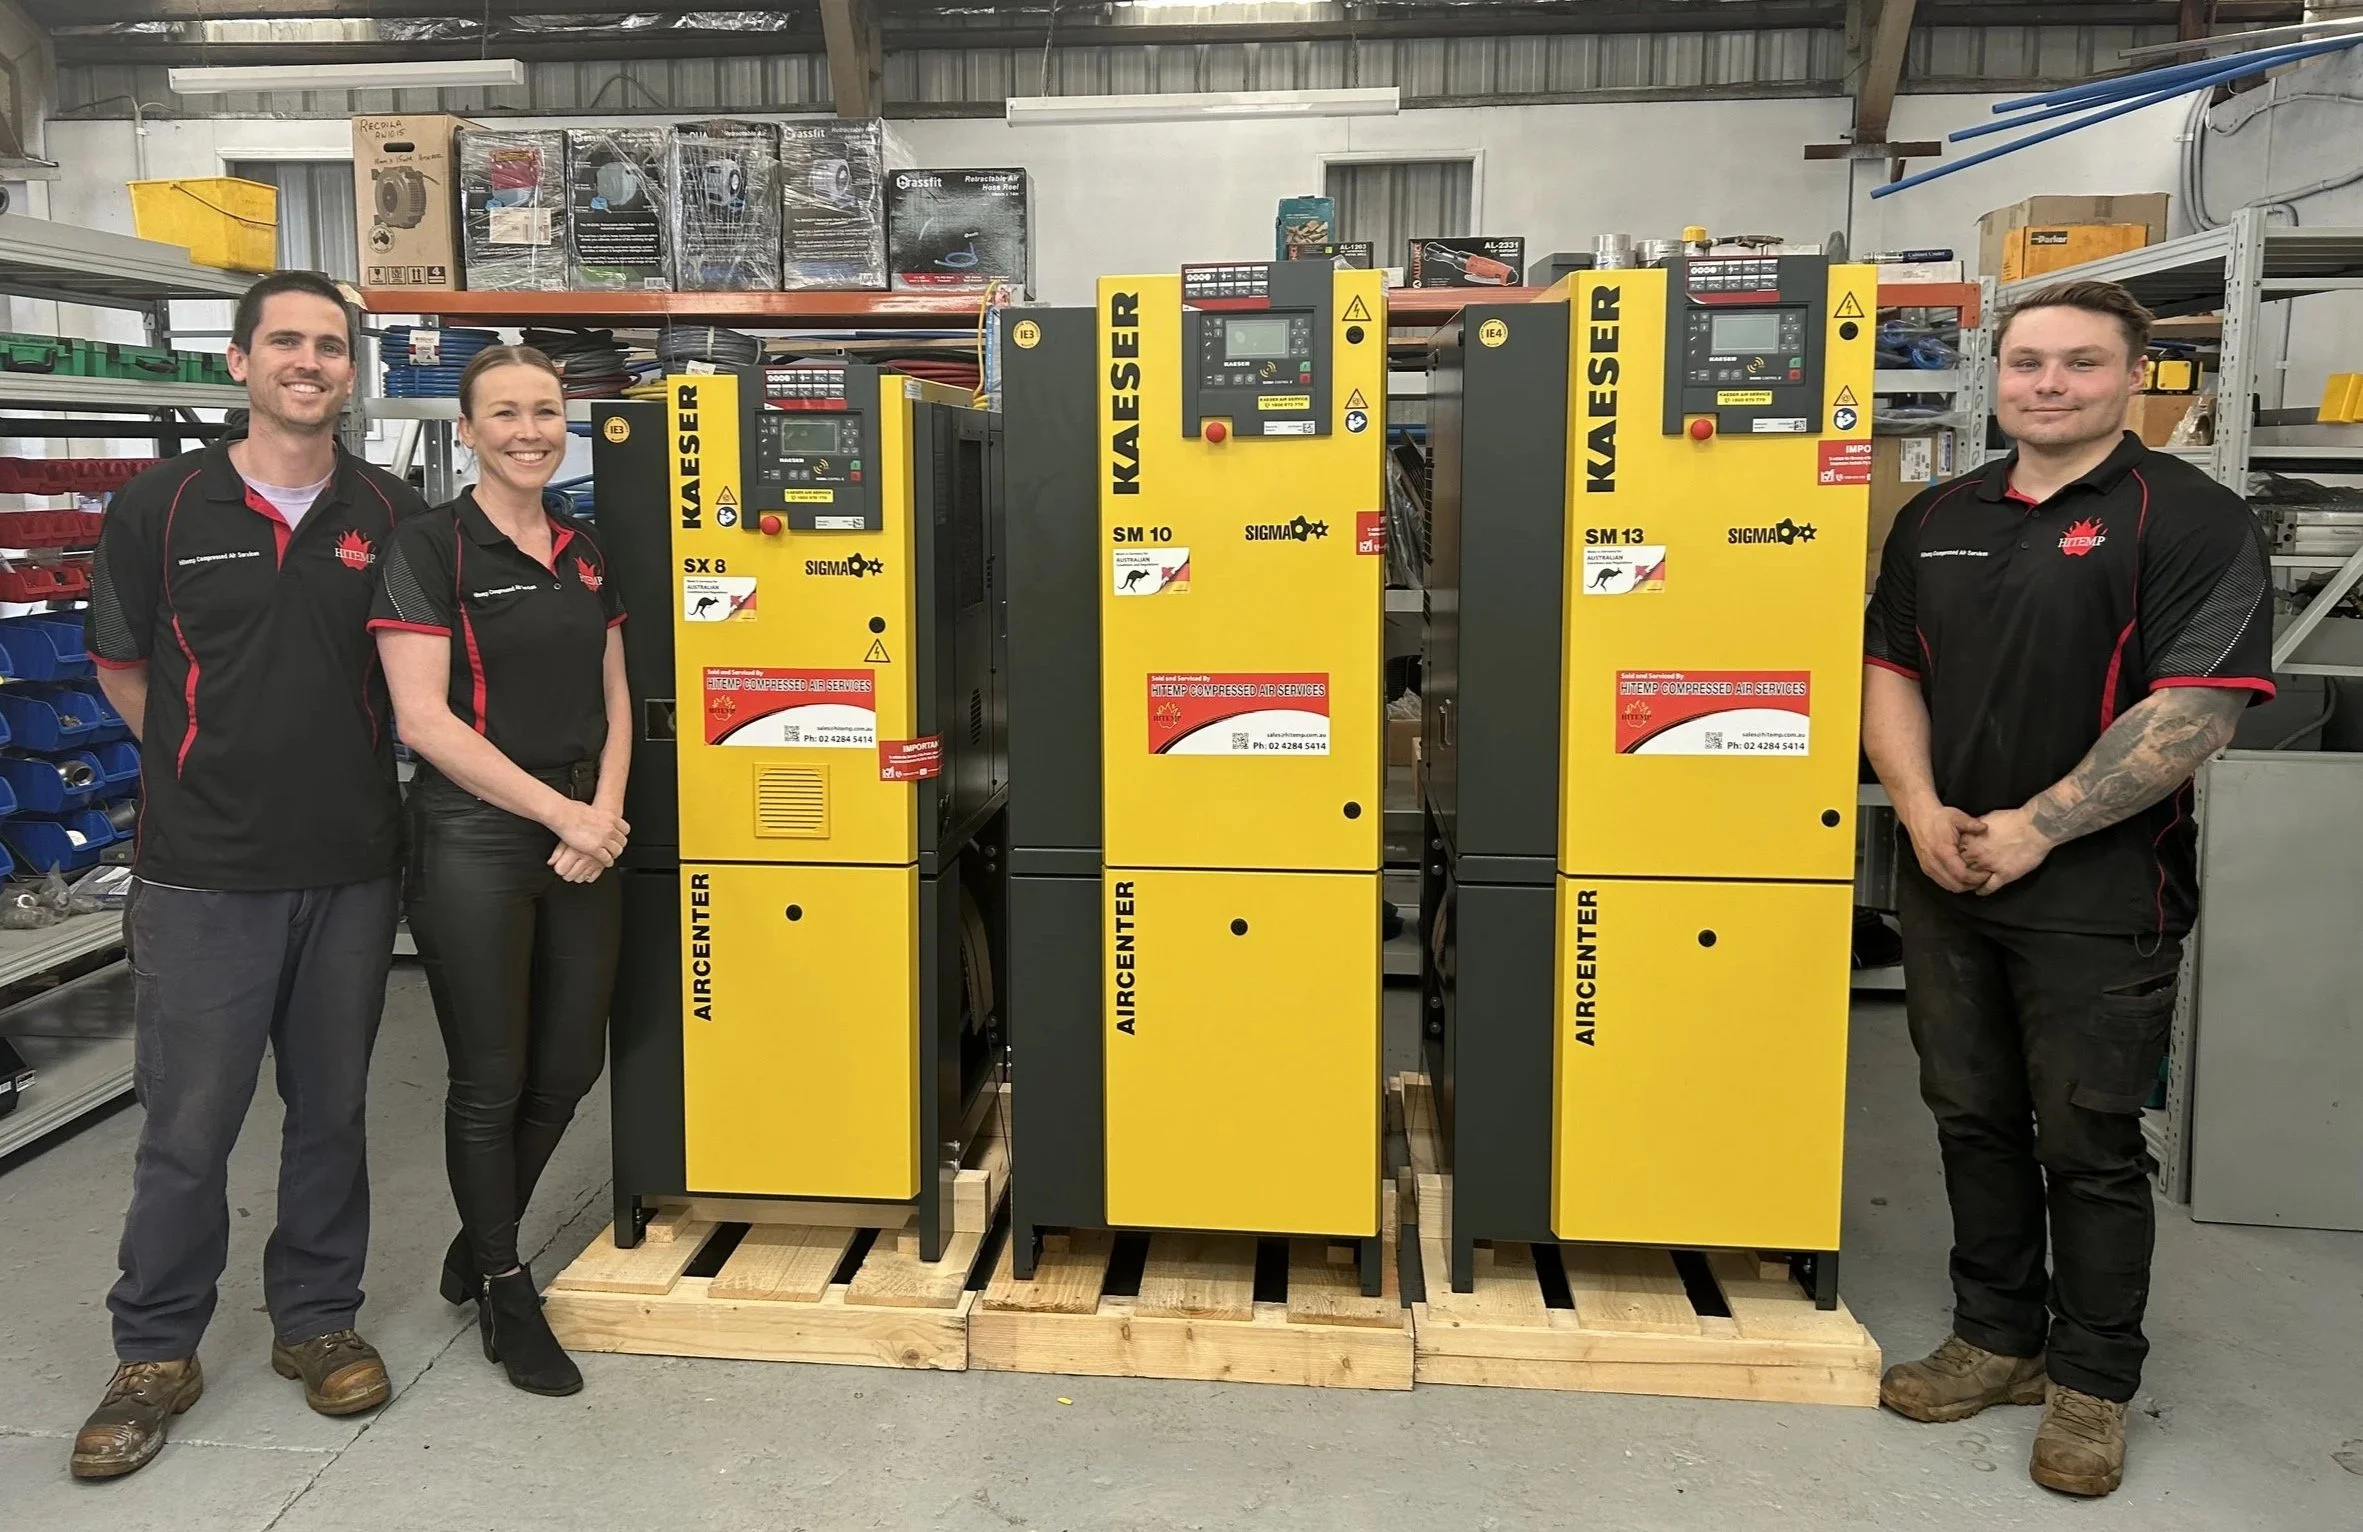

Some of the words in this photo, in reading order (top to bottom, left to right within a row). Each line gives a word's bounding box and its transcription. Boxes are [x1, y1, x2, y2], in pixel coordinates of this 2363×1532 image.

[1009, 174, 1020, 182] Air
[1484, 241, 1519, 249] AL-2331
[2037, 234, 2067, 244] Parker
[1020, 329, 1035, 339] IE3
[1486, 328, 1502, 338] IE4
[1110, 291, 1141, 495] KAESER
[1586, 285, 1620, 493] KAESER
[610, 425, 624, 434] IE3
[679, 385, 702, 529] KAESER
[1113, 527, 1144, 542] SM
[1150, 526, 1172, 542] 10
[1245, 525, 1291, 541] SIGMA
[1585, 528, 1617, 544] SM
[1621, 528, 1644, 544] 13
[1728, 528, 1777, 544] SIGMA
[2057, 535, 2106, 548] HITEMP
[196, 553, 228, 562] Compressed
[334, 547, 376, 564] HITEMP
[684, 558, 710, 574] SX
[715, 559, 726, 574] 8
[806, 560, 849, 576] SIGMA
[756, 670, 764, 678] By
[1202, 675, 1211, 683] By
[1620, 672, 1634, 680] Sold
[1634, 672, 1646, 680] and
[1647, 672, 1674, 680] Serviced
[1675, 673, 1684, 681] By
[708, 677, 741, 691] HITEMP
[743, 678, 807, 692] COMPRESSED
[809, 680, 825, 692] AIR
[826, 680, 872, 692] SERVICES
[1151, 684, 1188, 697] HITEMP
[1189, 684, 1257, 697] COMPRESSED
[1259, 684, 1276, 697] AIR
[1277, 684, 1325, 697] SERVICES
[1620, 682, 1659, 695] HITEMP
[1661, 682, 1733, 695] COMPRESSED
[1735, 682, 1754, 695] AIR
[1755, 682, 1806, 695] SERVICES
[803, 734, 818, 743] Ph:
[818, 735, 830, 743] 02
[831, 735, 851, 743] 4284
[852, 735, 873, 744] 5414
[1253, 741, 1267, 750] Ph:
[1268, 742, 1280, 750] 02
[1281, 742, 1303, 750] 4284
[1305, 742, 1327, 750] 5414
[1727, 741, 1743, 750] Ph:
[1743, 741, 1756, 750] 02
[1757, 741, 1780, 750] 4284
[1782, 741, 1805, 750] 5414
[691, 873, 712, 1022] AIRCENTER
[1115, 881, 1135, 1036] AIRCENTER
[1575, 890, 1597, 1047] AIRCENTER
